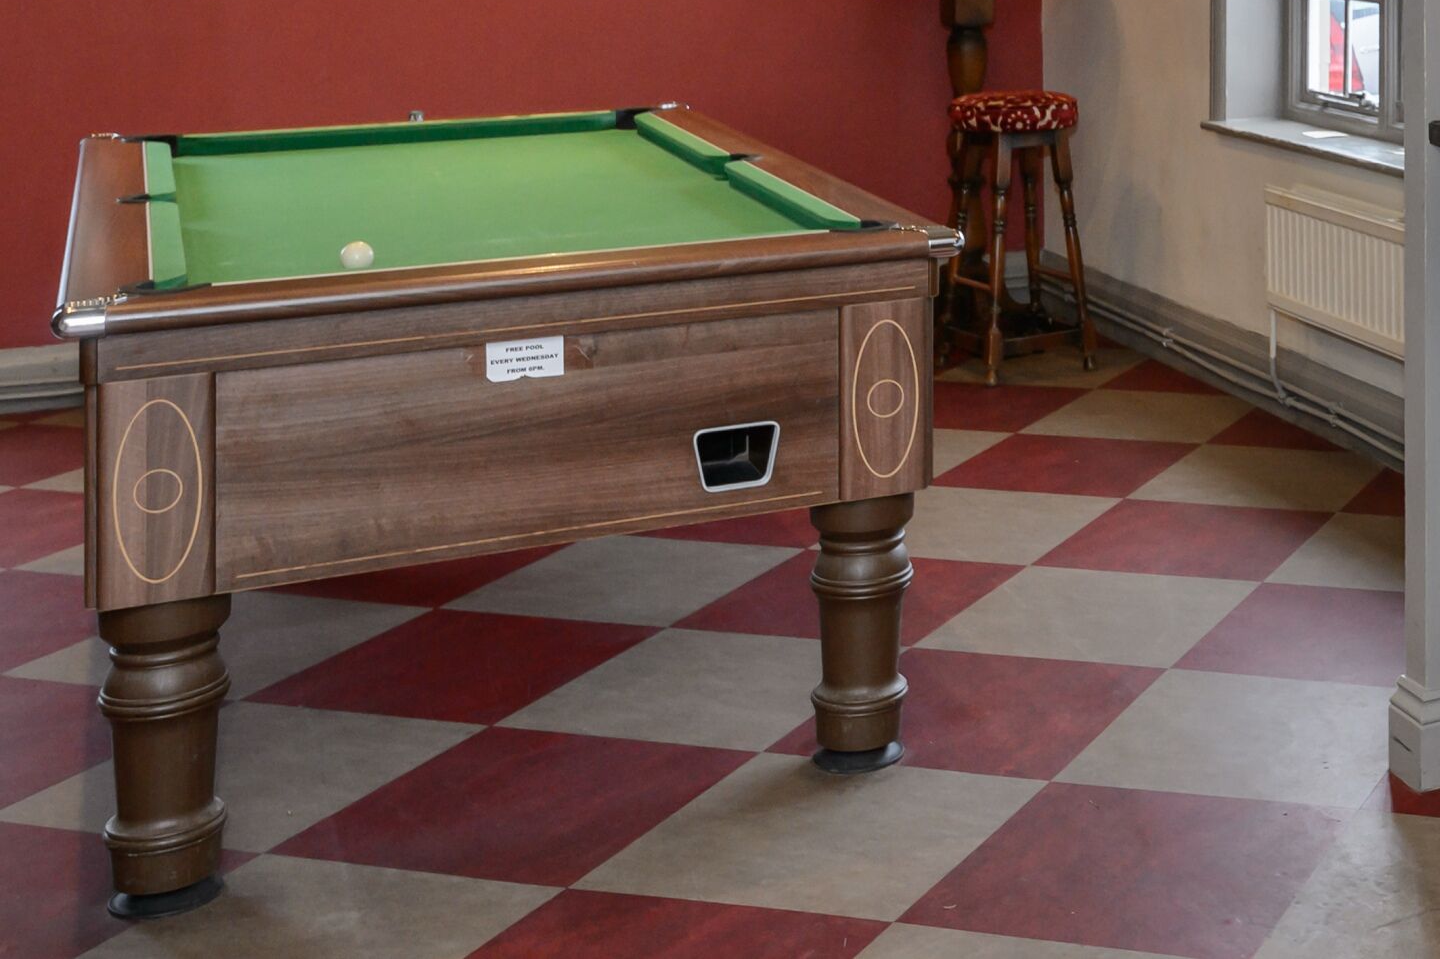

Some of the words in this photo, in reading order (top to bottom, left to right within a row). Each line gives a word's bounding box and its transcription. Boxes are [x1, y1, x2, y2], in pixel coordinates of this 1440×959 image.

[505, 345, 524, 353] FREE
[490, 357, 514, 365] EVERY
[515, 353, 559, 362] WEDNESDAY
[507, 366, 527, 374] FROM
